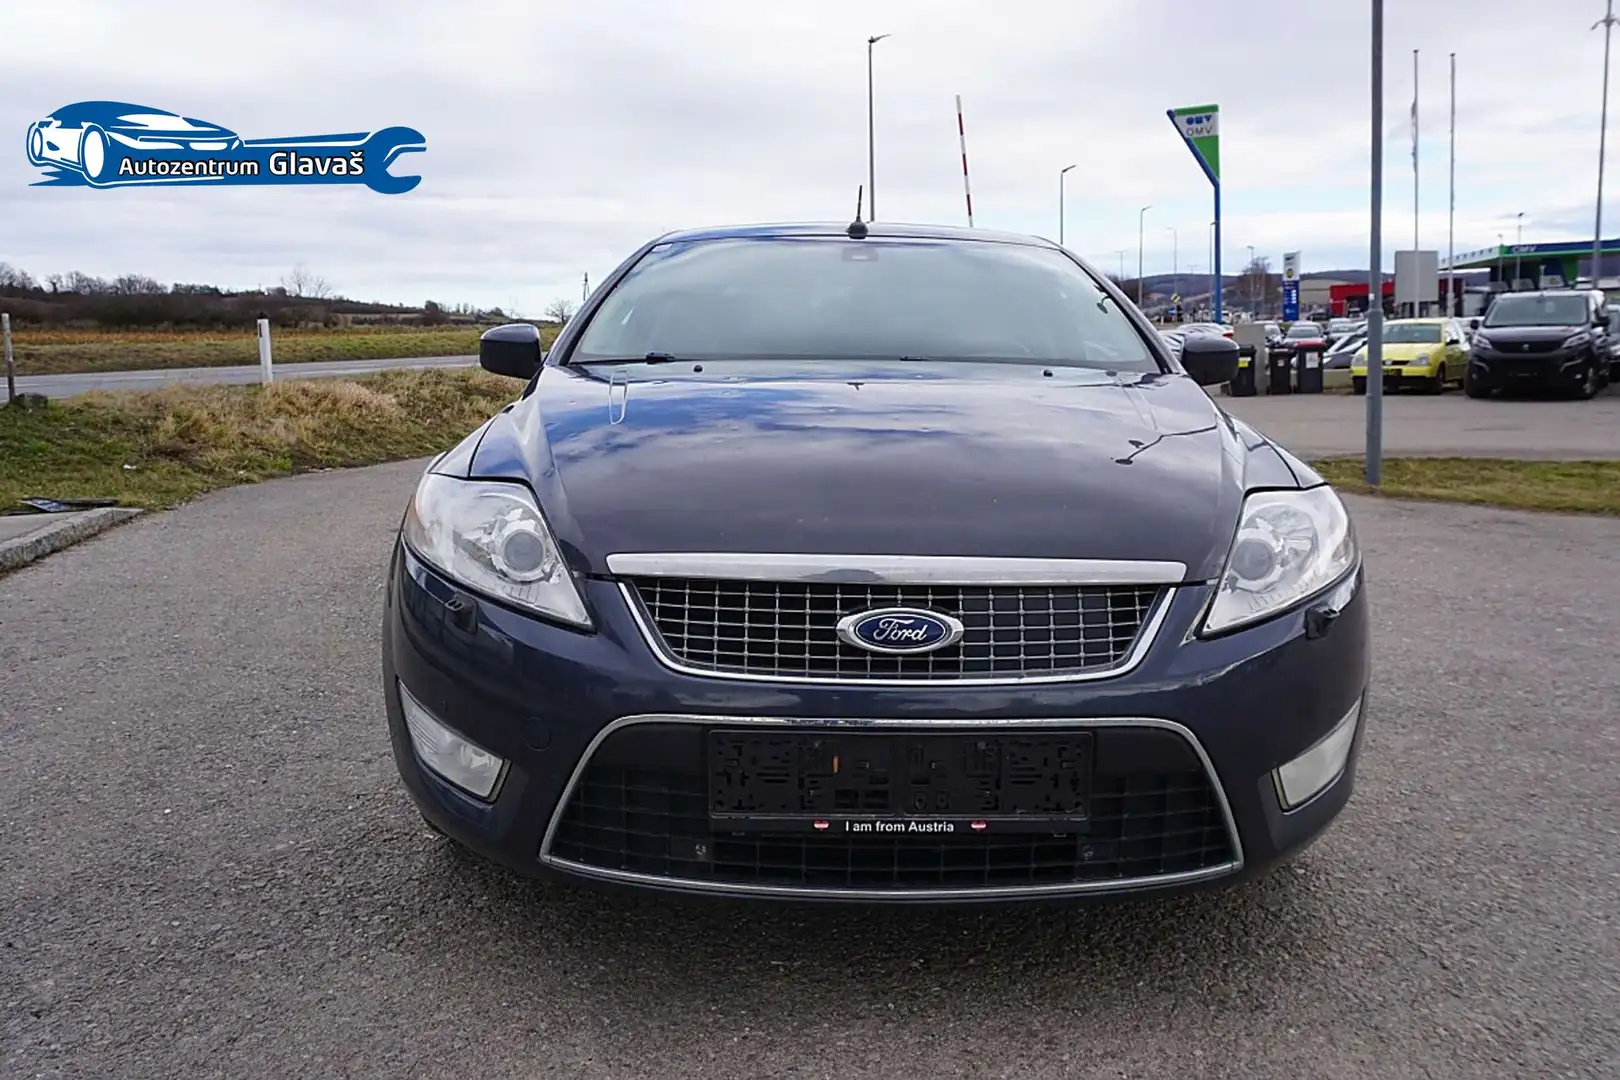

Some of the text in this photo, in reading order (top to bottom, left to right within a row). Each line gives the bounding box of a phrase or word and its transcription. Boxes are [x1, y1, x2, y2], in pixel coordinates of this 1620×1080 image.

[1186, 127, 1213, 136] OMV
[873, 618, 928, 640] Ford
[845, 821, 954, 832] I am from Austria
